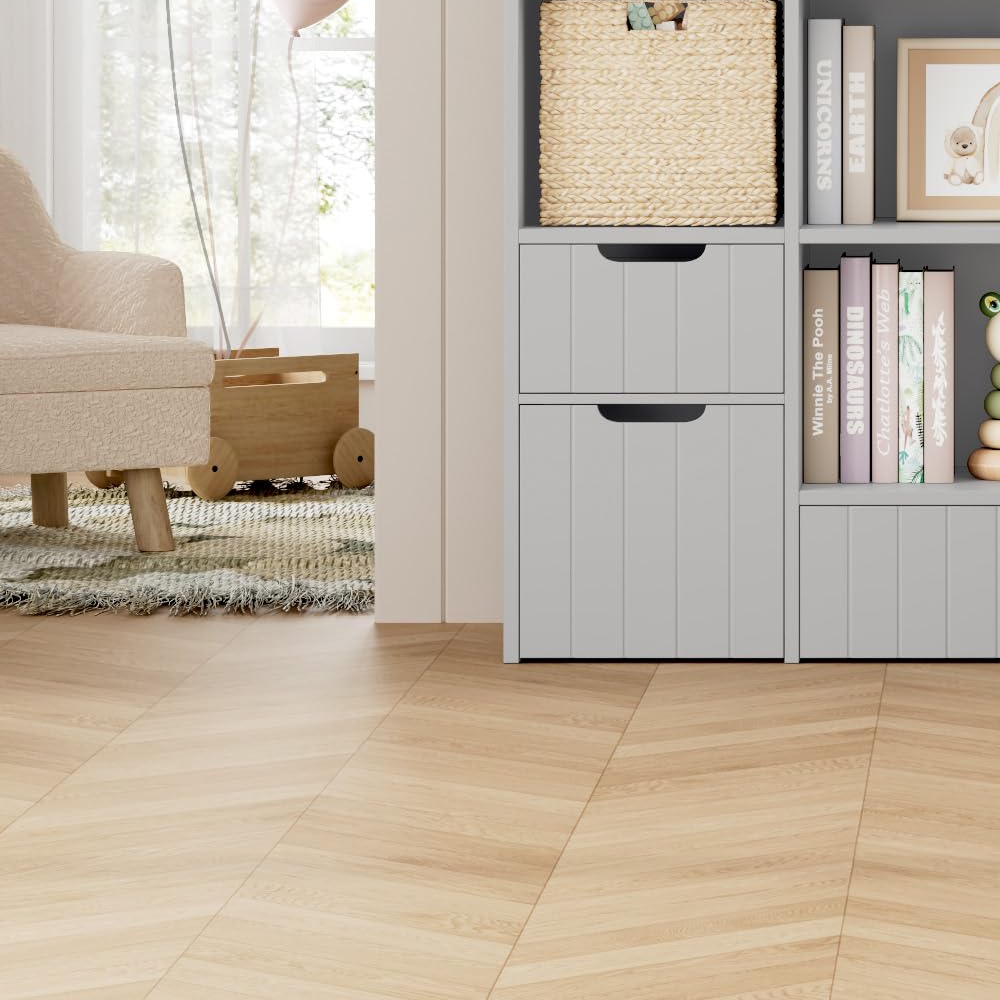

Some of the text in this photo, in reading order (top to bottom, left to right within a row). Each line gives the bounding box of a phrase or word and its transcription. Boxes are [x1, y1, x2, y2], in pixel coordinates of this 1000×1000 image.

[816, 59, 833, 192] UNICORNS
[848, 71, 866, 173] EARTH
[877, 289, 890, 334] Web
[812, 308, 824, 437] Winnie The Pooh
[826, 394, 834, 404] by
[846, 306, 865, 435] DINOSAURS
